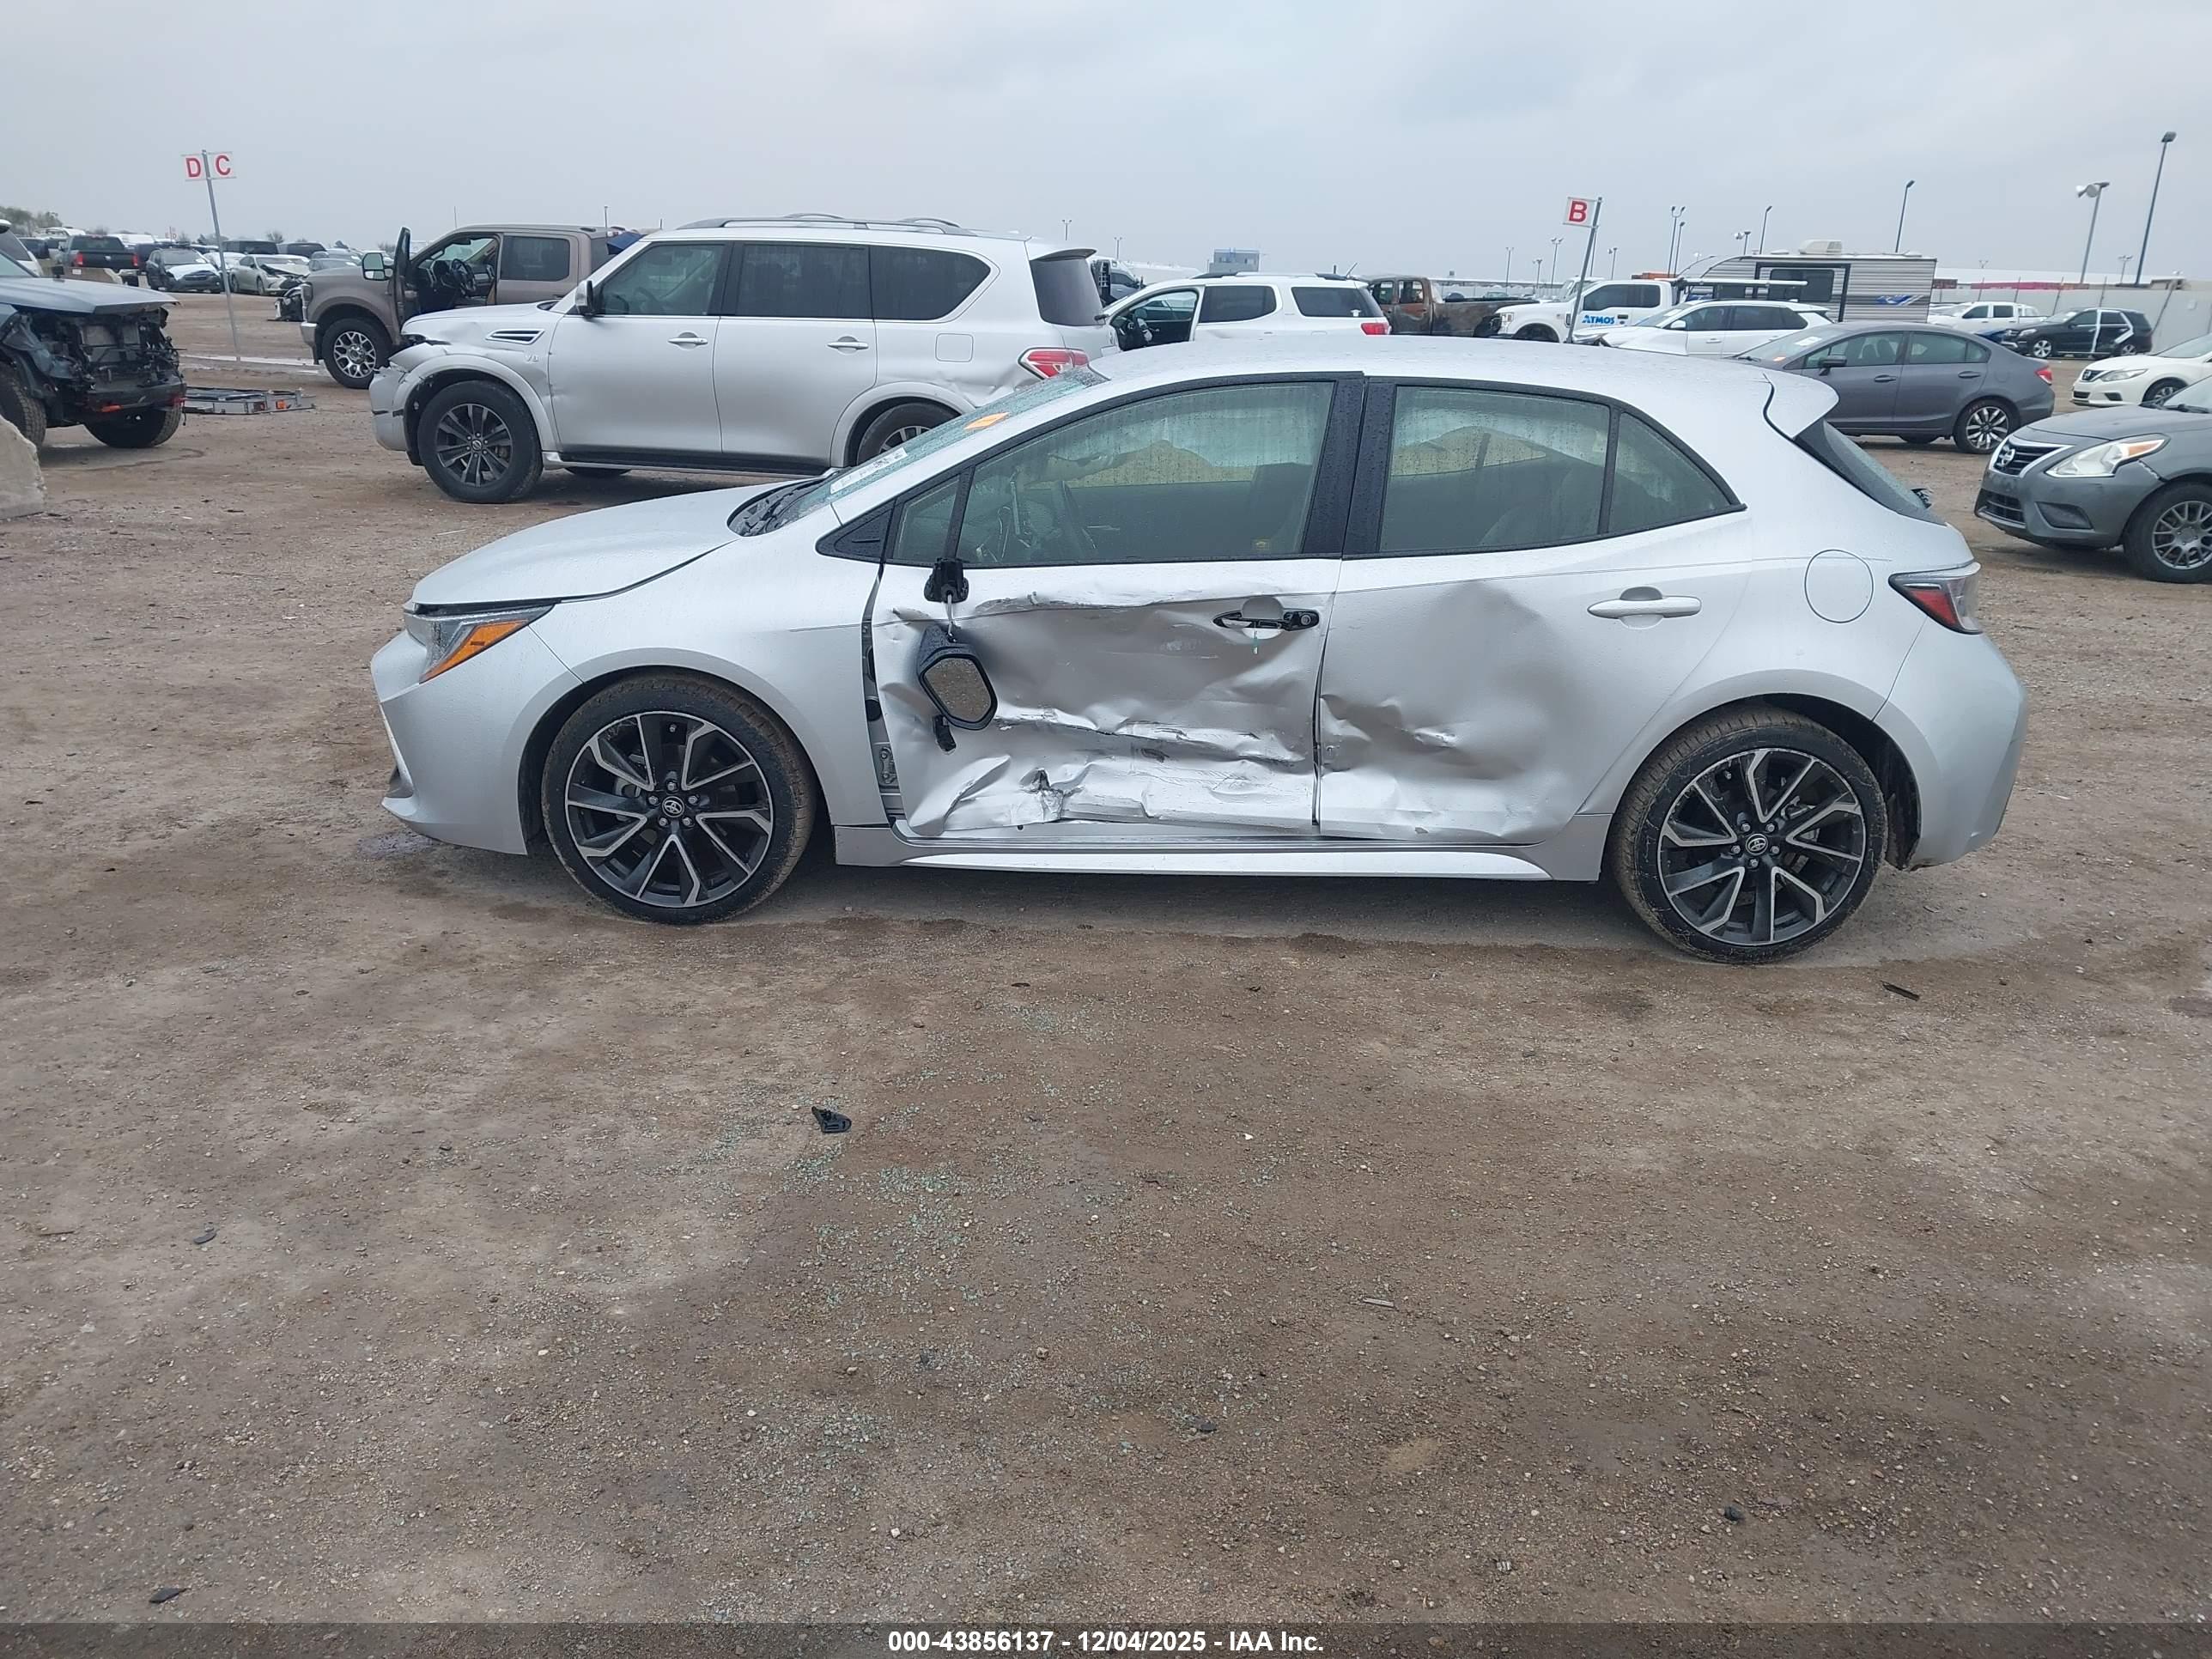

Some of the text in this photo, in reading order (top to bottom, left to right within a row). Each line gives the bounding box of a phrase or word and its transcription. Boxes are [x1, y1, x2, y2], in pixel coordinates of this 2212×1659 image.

[185, 158, 201, 178] D
[216, 155, 231, 176] C
[1569, 200, 1587, 223] B
[1582, 314, 1615, 325] ATMOS
